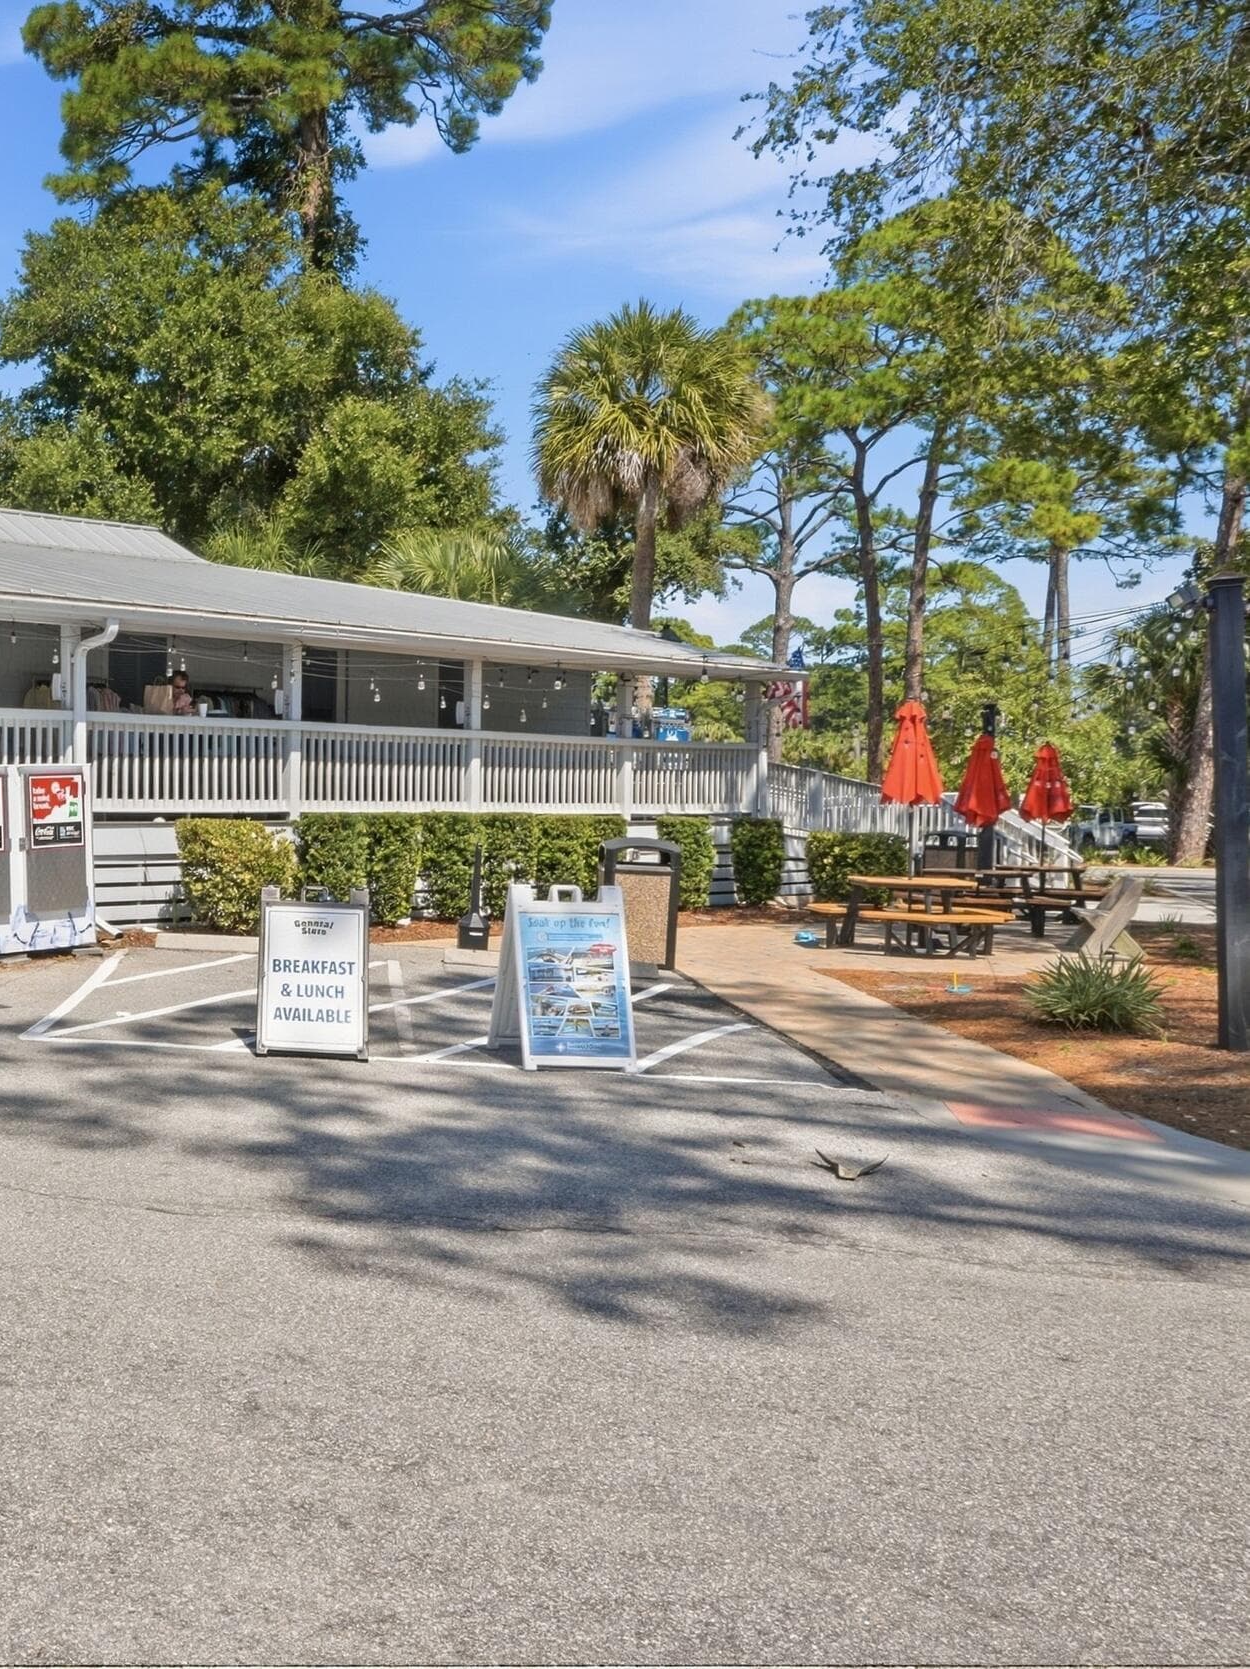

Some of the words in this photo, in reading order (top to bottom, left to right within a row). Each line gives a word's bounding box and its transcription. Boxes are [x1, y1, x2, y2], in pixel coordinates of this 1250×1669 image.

[272, 959, 356, 975] BREAKFAST
[280, 983, 292, 997] &
[296, 984, 345, 999] LUNCH
[273, 1007, 352, 1024] AVAILABLE
